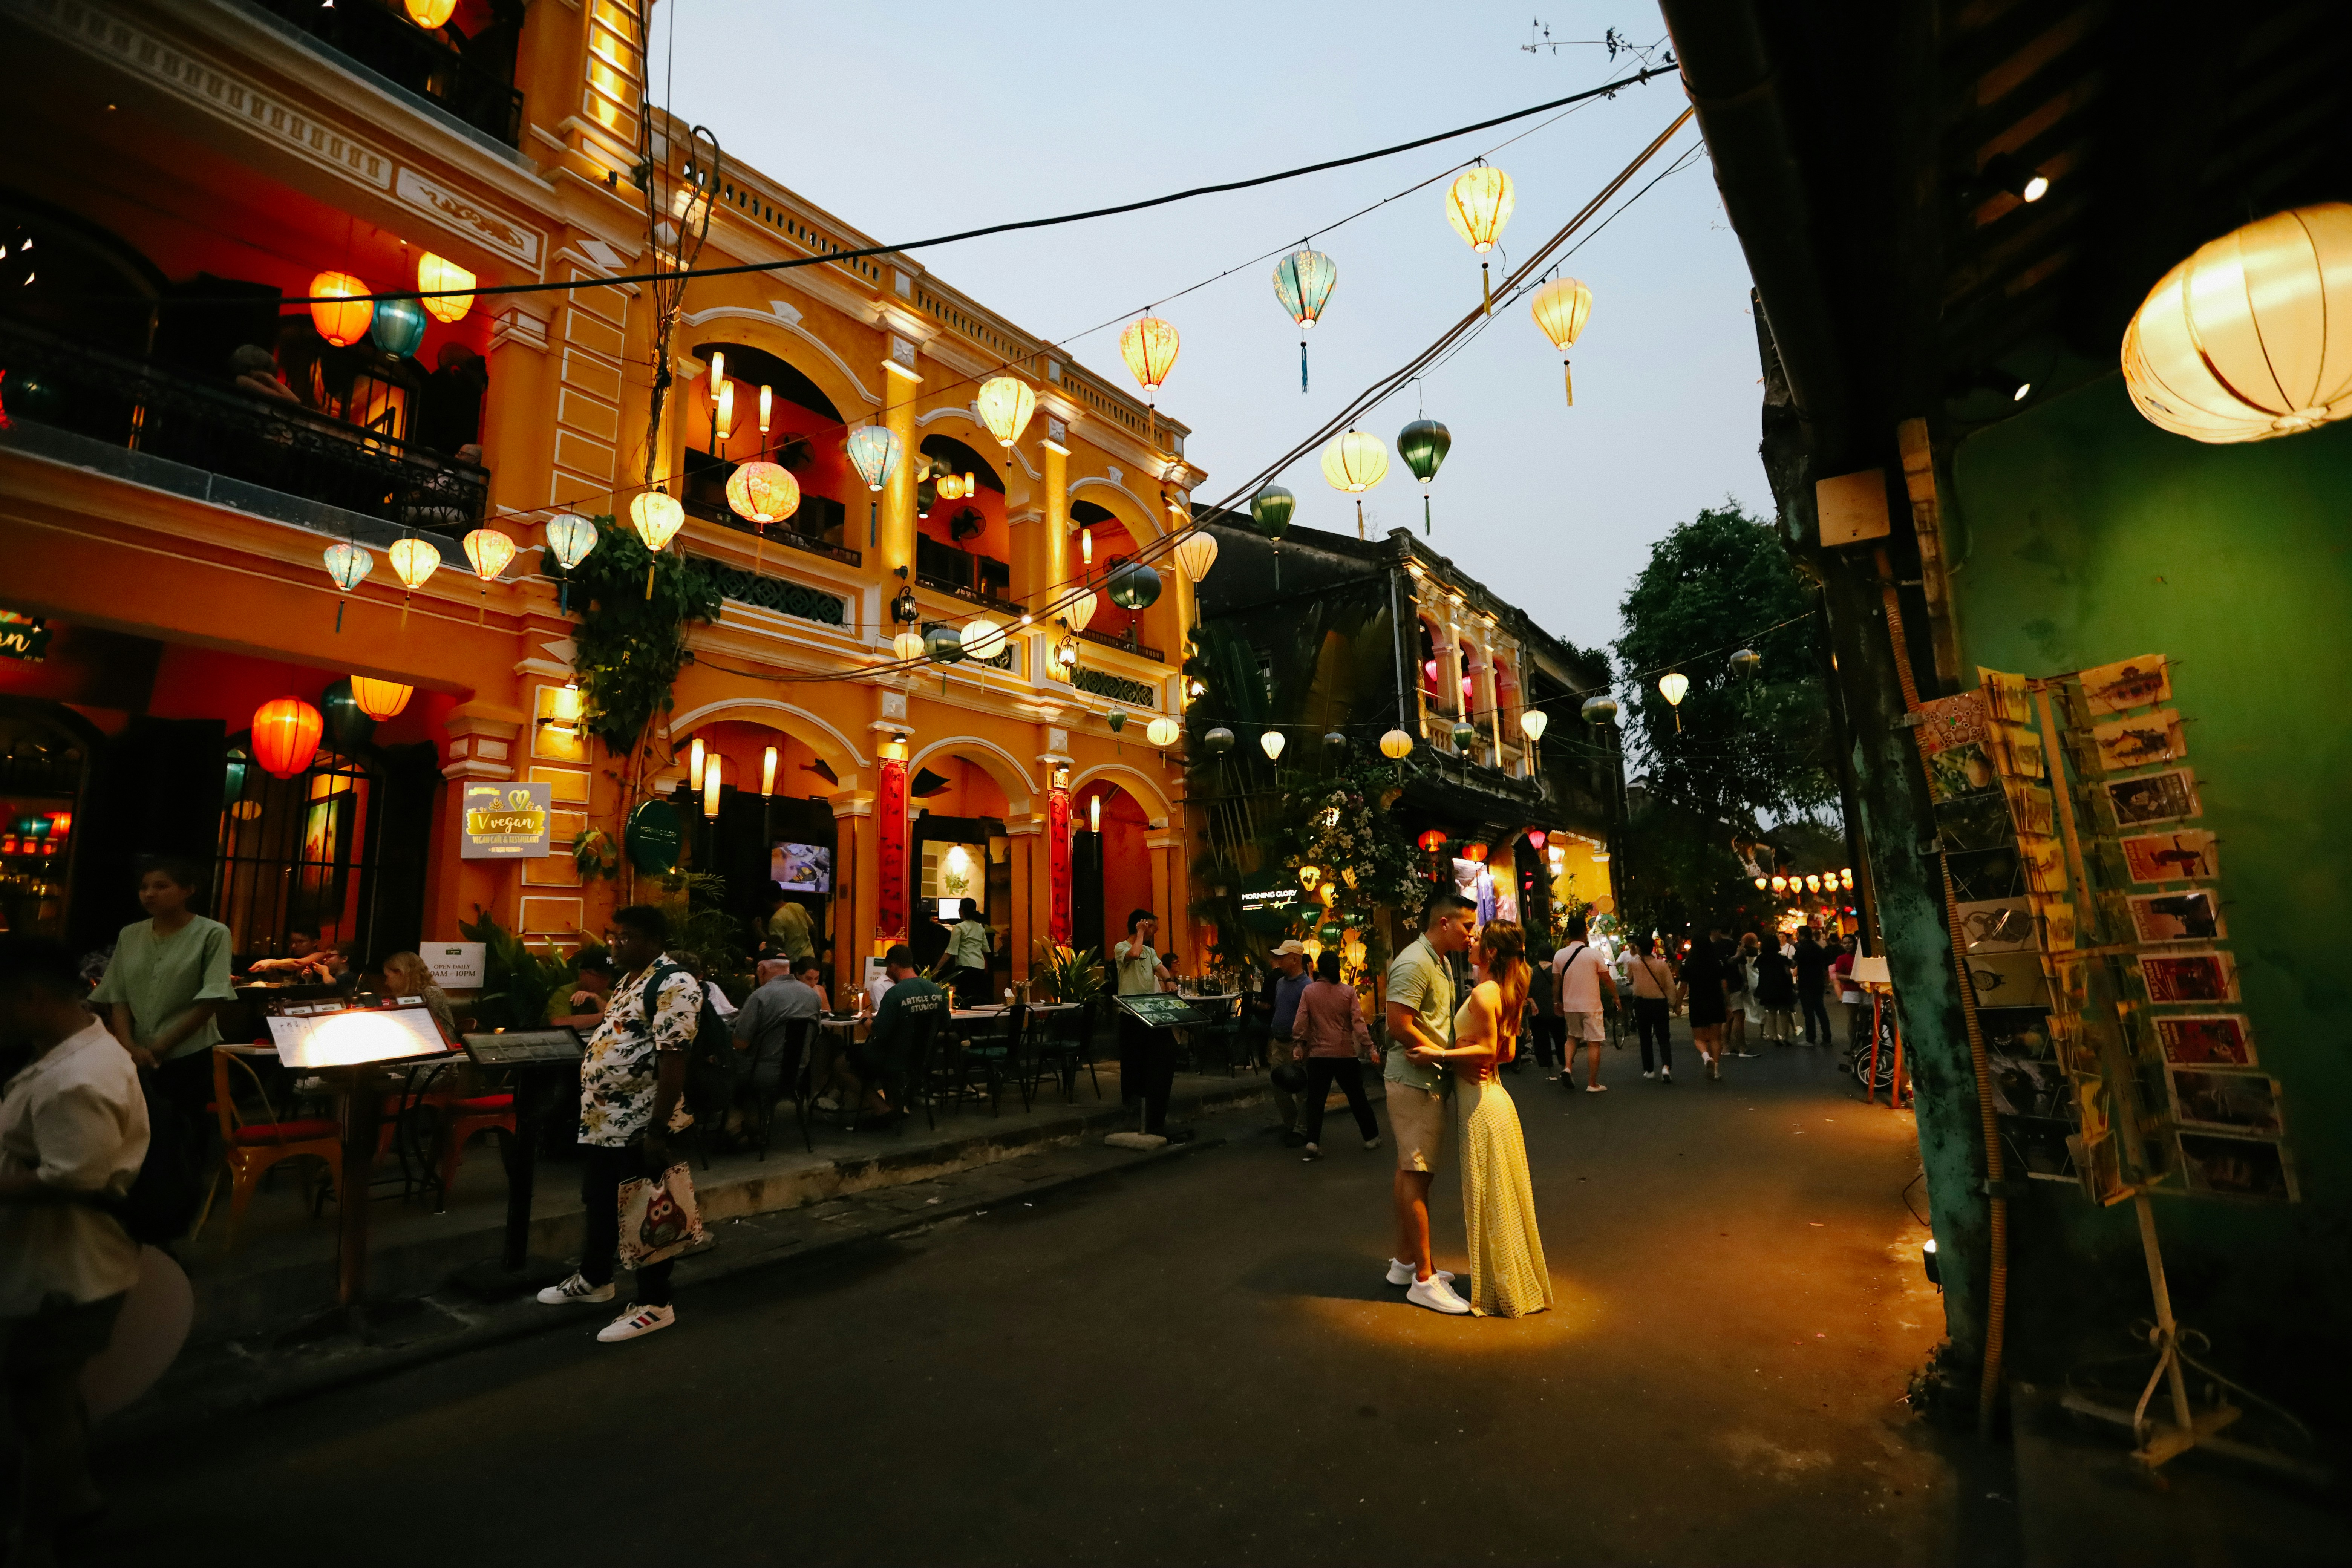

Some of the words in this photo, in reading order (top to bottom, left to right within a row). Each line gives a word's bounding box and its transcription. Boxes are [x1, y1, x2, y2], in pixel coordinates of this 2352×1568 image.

[1242, 891, 1275, 900] MORNING
[1276, 889, 1297, 897] GLORY
[901, 995, 928, 1007] ARTICLE
